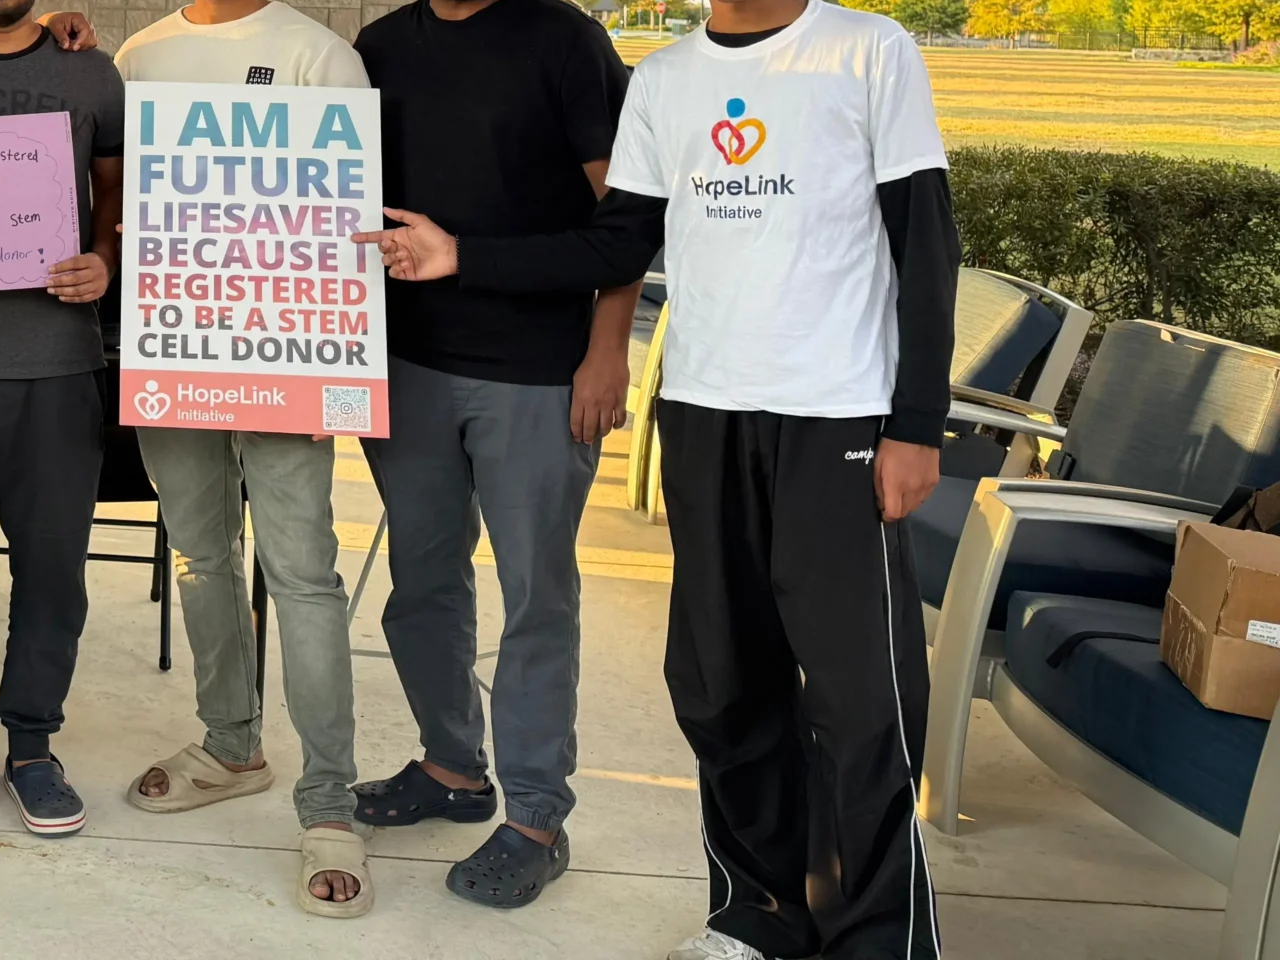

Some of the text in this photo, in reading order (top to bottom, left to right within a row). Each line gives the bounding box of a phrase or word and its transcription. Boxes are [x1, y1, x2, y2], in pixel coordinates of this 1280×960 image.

[140, 100, 363, 150] I AM A
[139, 154, 365, 200] FUTURE
[138, 201, 362, 238] LIFESAVER
[705, 205, 763, 219] Initiative
[138, 236, 367, 274] BECAUSE I
[138, 272, 367, 306] REGISTERED
[138, 303, 369, 336] TO BE A STEM
[137, 332, 369, 367] CELL DONOR
[177, 382, 286, 408] HopeLink
[177, 408, 235, 423] Initiative
[844, 447, 874, 465] camp
